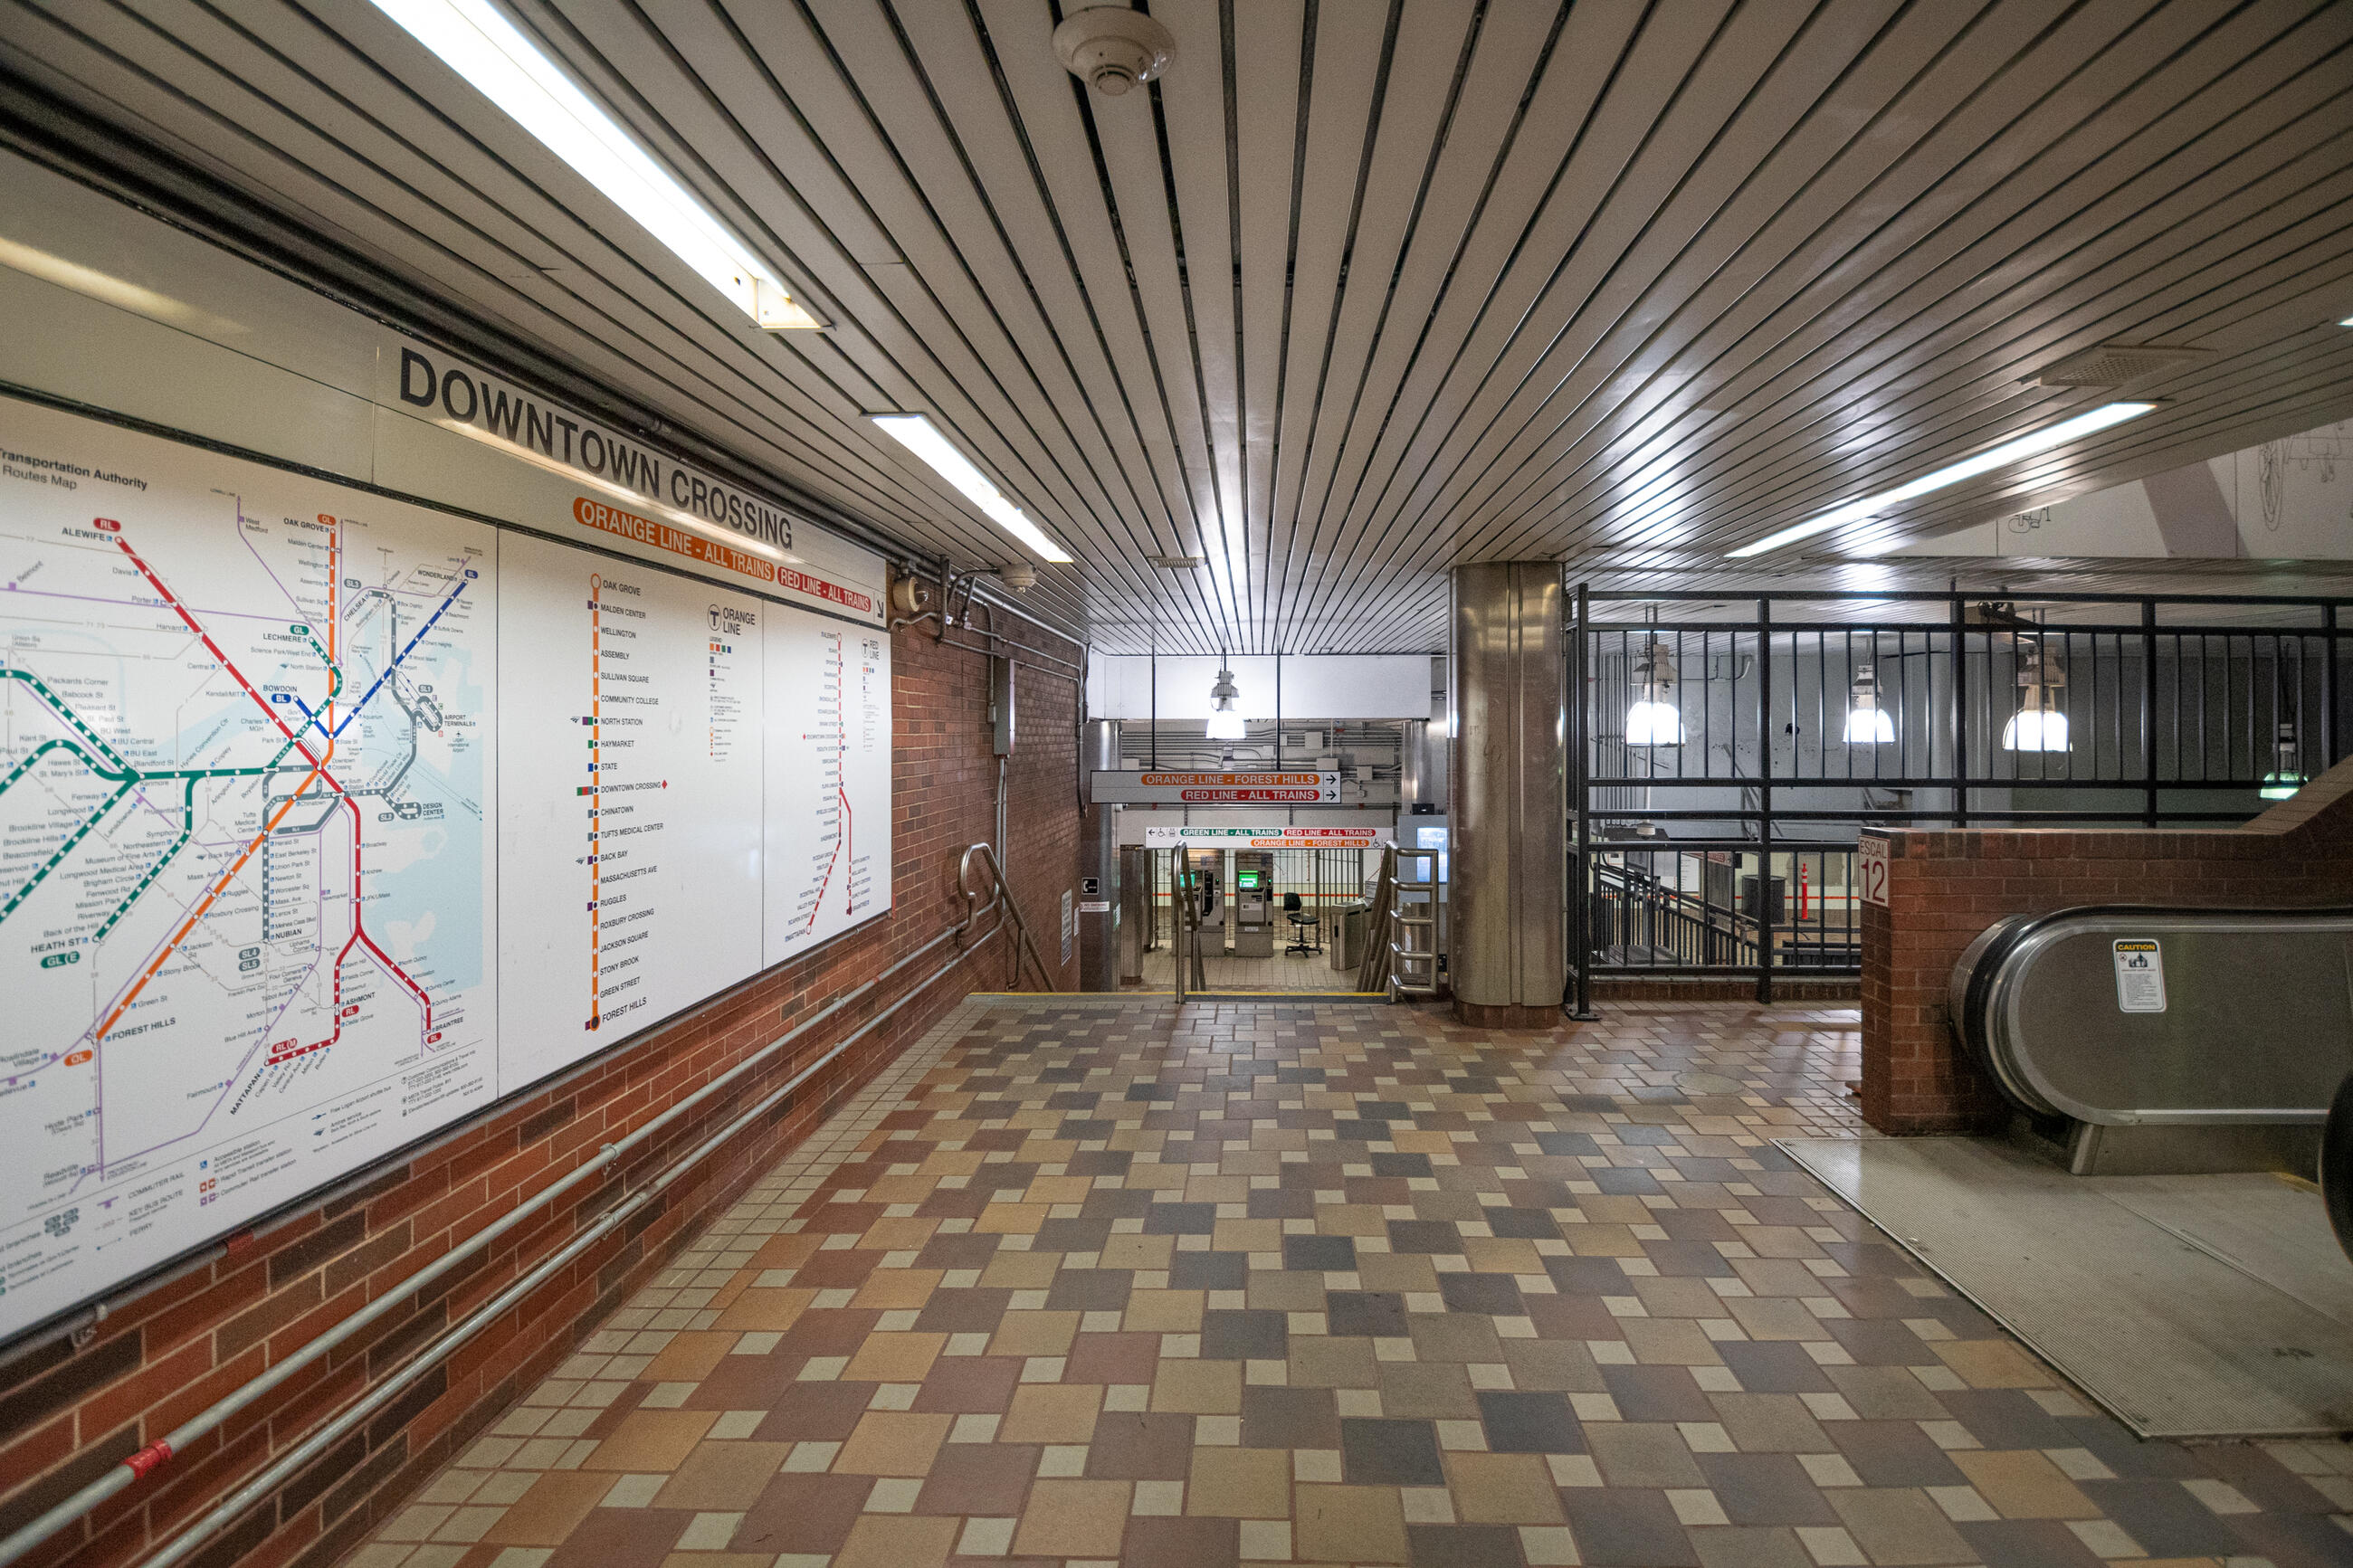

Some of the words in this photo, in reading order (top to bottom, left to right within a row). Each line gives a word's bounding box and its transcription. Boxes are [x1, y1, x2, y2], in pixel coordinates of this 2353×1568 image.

[400, 347, 660, 498] DOWNTOWN
[671, 469, 792, 549] CROSSING
[2, 465, 47, 484] Routes
[52, 471, 78, 490] Map
[93, 469, 148, 491] Authority
[100, 519, 115, 530] RL
[283, 518, 298, 527] OAK
[300, 520, 325, 532] GROVE
[321, 515, 331, 524] OL
[62, 527, 105, 542] ALEWIFE
[581, 501, 655, 544] ORANGE
[660, 527, 691, 555] LINE
[704, 544, 728, 566] ALL
[730, 551, 771, 580] TRAINS
[112, 566, 132, 576] Davis
[417, 570, 454, 582] WONDERLAND
[603, 580, 617, 590] OAK
[619, 584, 641, 595] GROVE
[781, 568, 800, 589] RED
[803, 575, 821, 595] LINE
[828, 585, 843, 603] ALL
[843, 590, 869, 611] TRAINS
[131, 595, 152, 604] Porter
[344, 597, 367, 622] CHELSEA
[601, 604, 624, 614] MALDEN
[624, 609, 646, 619] CENTER
[723, 607, 755, 625] ORANGE
[157, 623, 182, 632] Harvard
[601, 627, 636, 639] WELLINGTON
[723, 621, 741, 636] LINE
[262, 633, 301, 643] LECHMERE
[601, 650, 630, 660] ASSEMBLY
[187, 662, 209, 670] Central
[47, 677, 83, 686] Packards
[86, 678, 109, 686] Corner
[601, 672, 627, 681] SULLIVAN
[628, 675, 650, 683] SQUARE
[262, 684, 298, 692] BOWDOIN
[601, 695, 634, 704] COMMUNITY
[635, 697, 659, 705] COLLEGE
[601, 763, 617, 771] STATE
[1147, 775, 1196, 784] ORANGE
[1199, 775, 1224, 784] LINE
[1235, 775, 1280, 784] FOREST
[1282, 775, 1315, 784] HILLS
[601, 784, 634, 794] DOWNTOWN
[635, 782, 661, 790] CROSSING
[71, 793, 100, 802] Fenway
[1186, 791, 1209, 800] RED
[1213, 791, 1237, 800] LINE
[1248, 791, 1270, 800] ALL
[1272, 791, 1315, 800] TRAINS
[48, 807, 87, 816] Longwood
[144, 807, 177, 815] Prudential
[423, 802, 443, 810] DESIGN
[601, 805, 634, 816] CHINATOWN
[9, 824, 46, 832] Brookline
[48, 822, 73, 832] Village
[601, 830, 618, 839] TUFTS
[619, 825, 643, 835] MEDICAL
[643, 822, 664, 832] CENTER
[146, 830, 180, 839] Symphony
[4, 838, 41, 847] Brookline
[43, 834, 59, 843] Hills
[123, 840, 166, 851] Northeastern
[3, 849, 53, 860] Beaconsfield
[1860, 840, 1886, 859] ESCAL
[601, 853, 616, 861] BACK
[617, 851, 628, 859] BAY
[600, 868, 647, 884] MASSACHUSETTS
[648, 865, 657, 874] AVE
[1861, 858, 1886, 903] 12
[600, 894, 627, 907] RUGGLES
[77, 910, 110, 920] Riverway
[600, 916, 626, 930] ROXBURY
[628, 908, 654, 921] CROSSING
[275, 928, 302, 939] NUBIAN
[31, 940, 65, 954] HEATH
[68, 937, 81, 947] ST
[600, 939, 626, 953] JACKSON
[627, 931, 649, 944] SQUARE
[242, 948, 257, 958] SL4
[47, 956, 63, 965] GL
[243, 960, 257, 971] SL5
[600, 964, 619, 975] STONY
[620, 955, 639, 969] BROOK
[600, 986, 619, 999] GREEN
[620, 976, 641, 991] STREET
[138, 998, 159, 1008] Green
[346, 992, 376, 1006] ASHMONT
[346, 1008, 355, 1016] RL
[602, 1005, 628, 1023] FOREST
[629, 996, 647, 1011] HILLS
[112, 1025, 148, 1041] FOREST
[150, 1017, 176, 1030] HILLS
[435, 1017, 464, 1031] BRAINTREE
[275, 1042, 286, 1051] RL
[71, 1052, 87, 1064] OL
[230, 1072, 261, 1116] MATTAPAN
